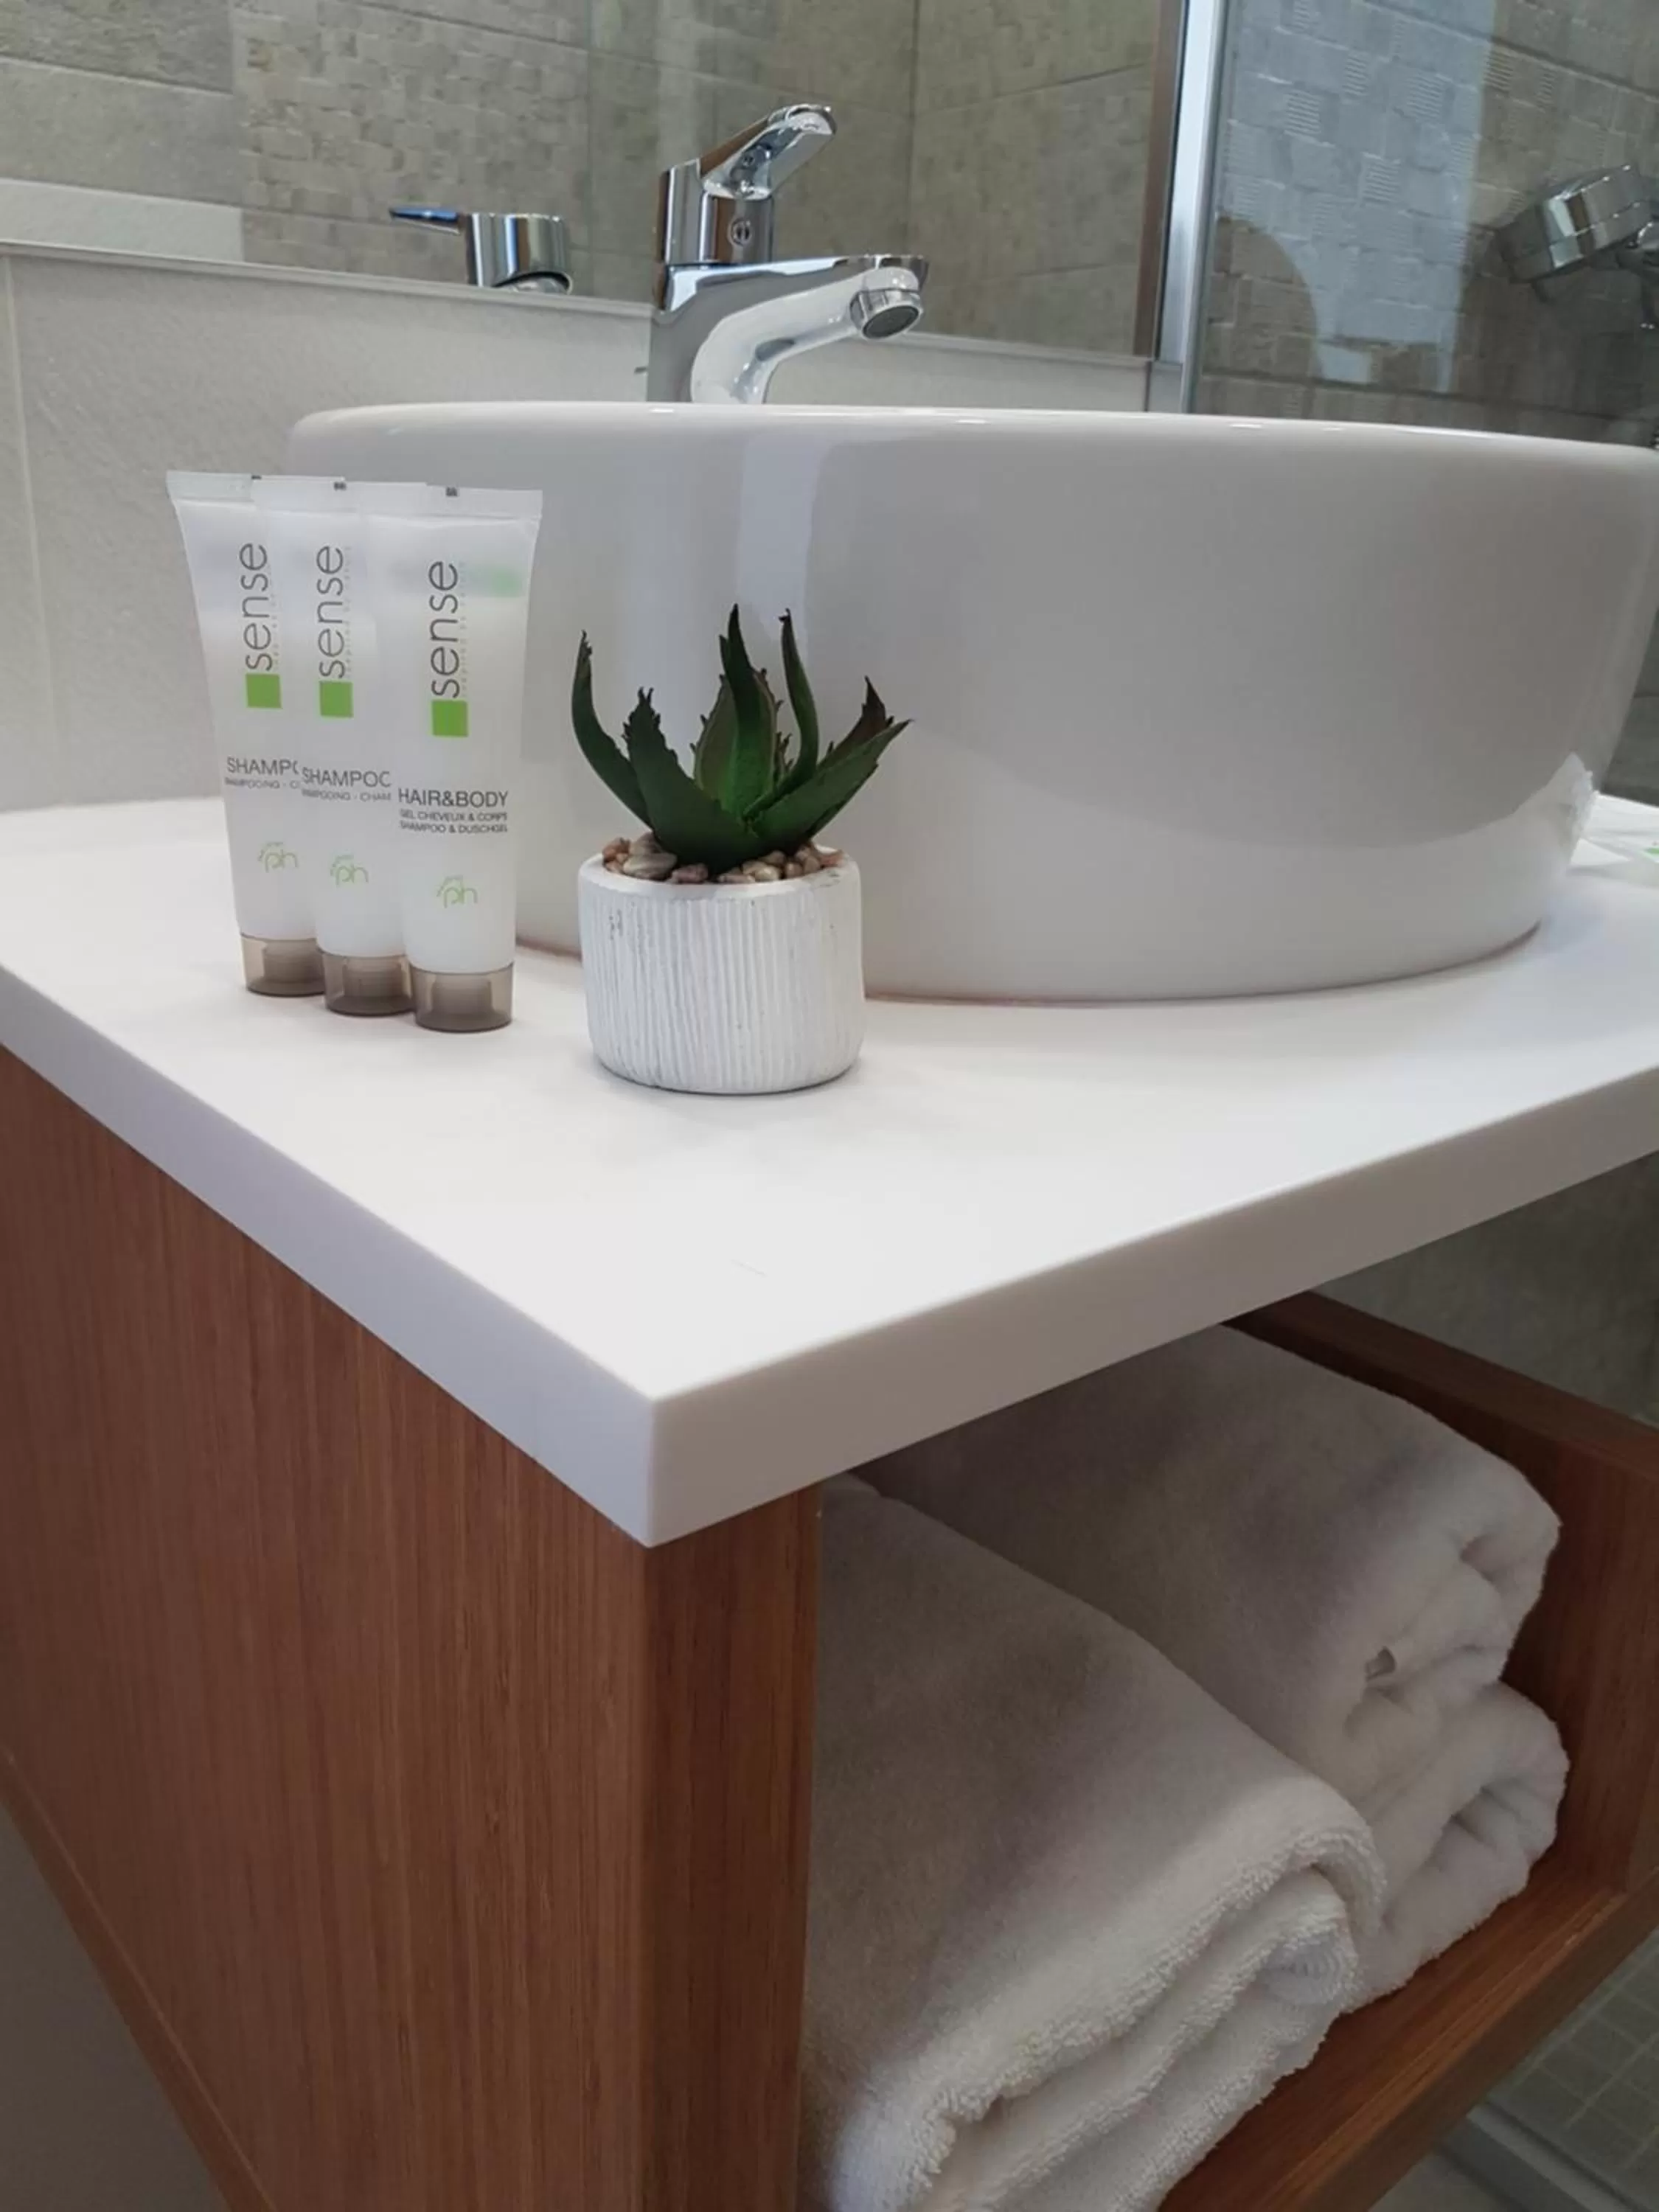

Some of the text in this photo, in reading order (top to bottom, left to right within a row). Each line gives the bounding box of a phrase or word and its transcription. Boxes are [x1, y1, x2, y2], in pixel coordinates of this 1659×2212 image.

[240, 543, 272, 671] sense
[316, 546, 345, 678] sense
[428, 561, 460, 698] sense
[398, 787, 508, 808] HAIR&BODY
